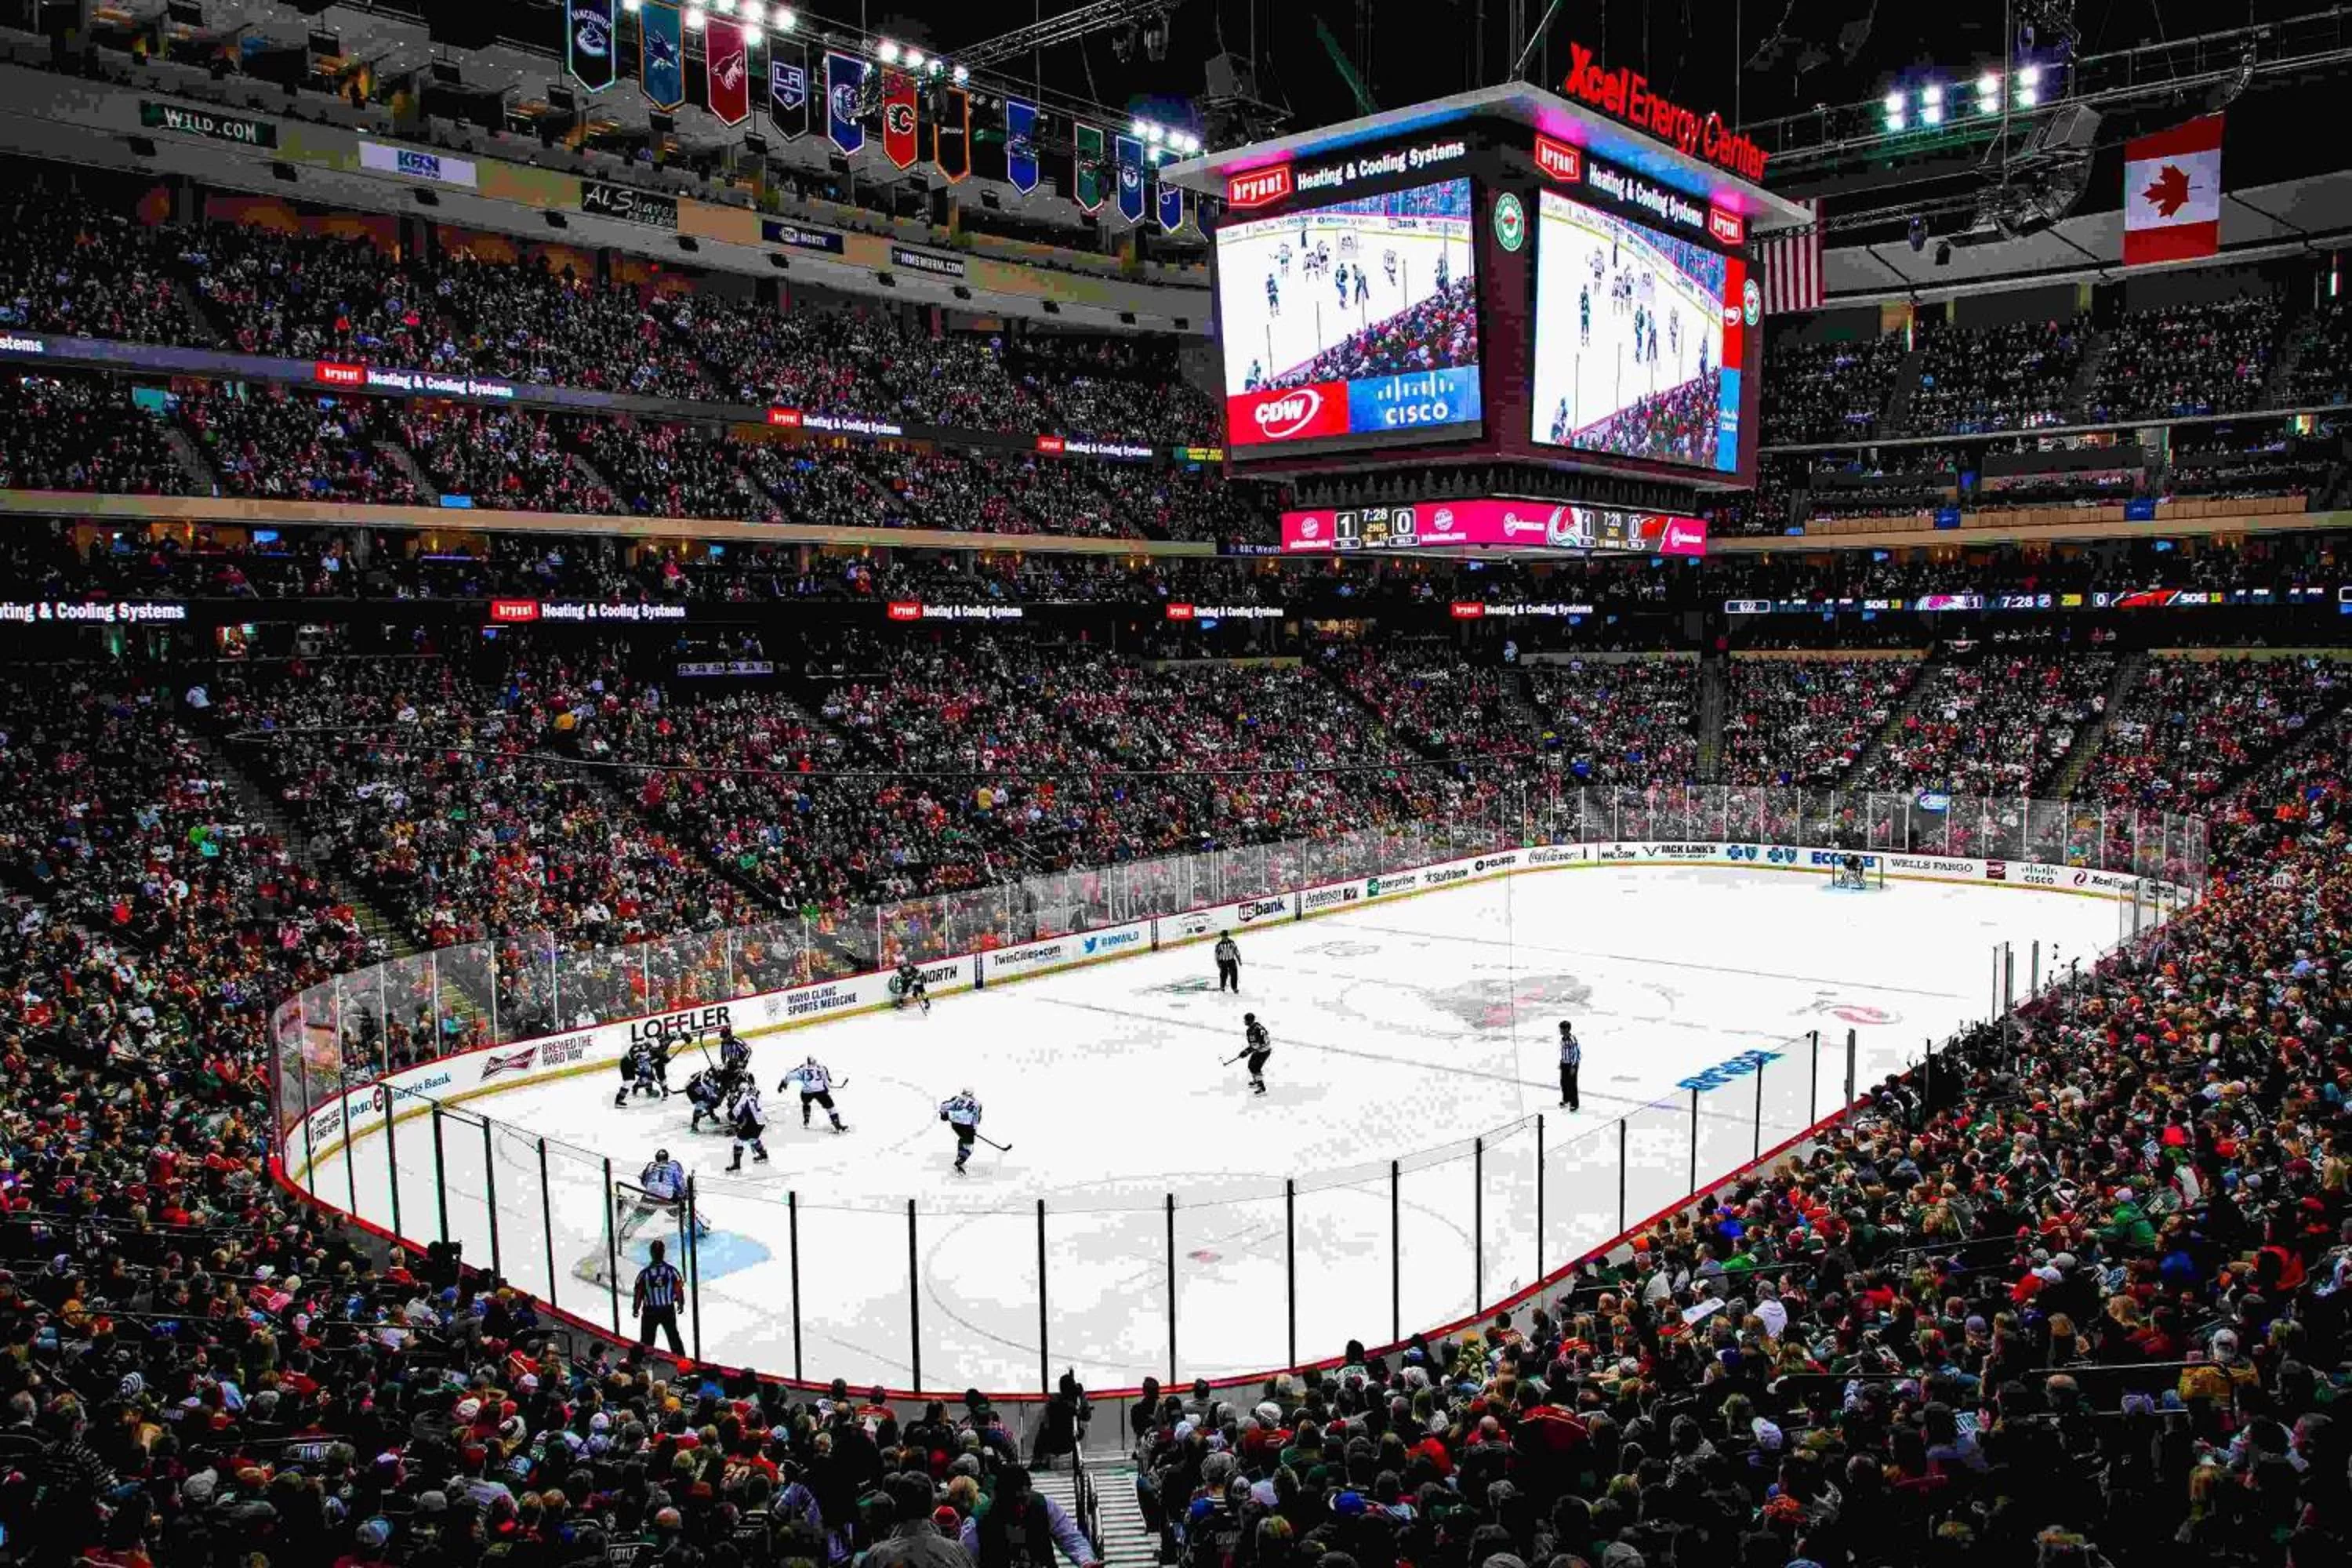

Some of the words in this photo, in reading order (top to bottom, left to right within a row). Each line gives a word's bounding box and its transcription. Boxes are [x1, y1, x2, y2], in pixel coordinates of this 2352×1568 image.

[1565, 41, 1629, 115] Xcel
[1629, 72, 1703, 158] Energy
[1704, 110, 1769, 180] Center
[1298, 170, 1343, 191] Heating
[1346, 163, 1356, 180] &
[1359, 152, 1406, 176] Cooling
[1410, 141, 1465, 168] Systems
[1541, 144, 1575, 174] bryant
[1233, 173, 1282, 201] bryant
[1589, 162, 1625, 201] Heating
[1628, 183, 1635, 201] &
[1636, 183, 1669, 219] Cooling
[1668, 195, 1704, 228] Systems
[0, 339, 43, 353] stems
[368, 370, 412, 390] Heating
[414, 376, 423, 388] &
[426, 378, 466, 394] Cooling
[469, 381, 514, 397] Systems
[1255, 398, 1305, 426] CDW
[1386, 401, 1449, 426] CISCO
[1362, 509, 1388, 522] 7:28
[1397, 512, 1410, 534] 0
[1341, 516, 1350, 537] 1
[1585, 517, 1592, 536] 1
[1631, 517, 1639, 539] 0
[1864, 600, 1889, 609] SOG
[2002, 596, 2034, 608] 7:28
[2180, 593, 2208, 603] SOG
[0, 602, 35, 622] ting
[39, 602, 53, 619] &
[56, 602, 115, 622] Cooling
[119, 602, 185, 622] Systems
[543, 604, 585, 620] Heating
[588, 604, 597, 617] &
[600, 604, 639, 620] Cooling
[641, 604, 685, 620] Systems
[923, 604, 953, 619] Heating
[954, 605, 961, 617] &
[962, 604, 991, 619] Cooling
[992, 605, 1023, 619] Systems
[1485, 604, 1515, 616] Heating
[1526, 604, 1556, 615] Cooling
[1559, 604, 1593, 615] Systems
[1891, 858, 1930, 870] WELLS
[1933, 862, 1973, 873] FARGO
[2092, 875, 2112, 887] Xcel
[787, 992, 810, 1004] MAYO
[811, 985, 837, 1000] CLINIC
[788, 1001, 818, 1016] SPORTS
[821, 993, 857, 1008] MEDICINE
[631, 1006, 731, 1043] LOFFLER
[424, 1072, 452, 1090] Bank
